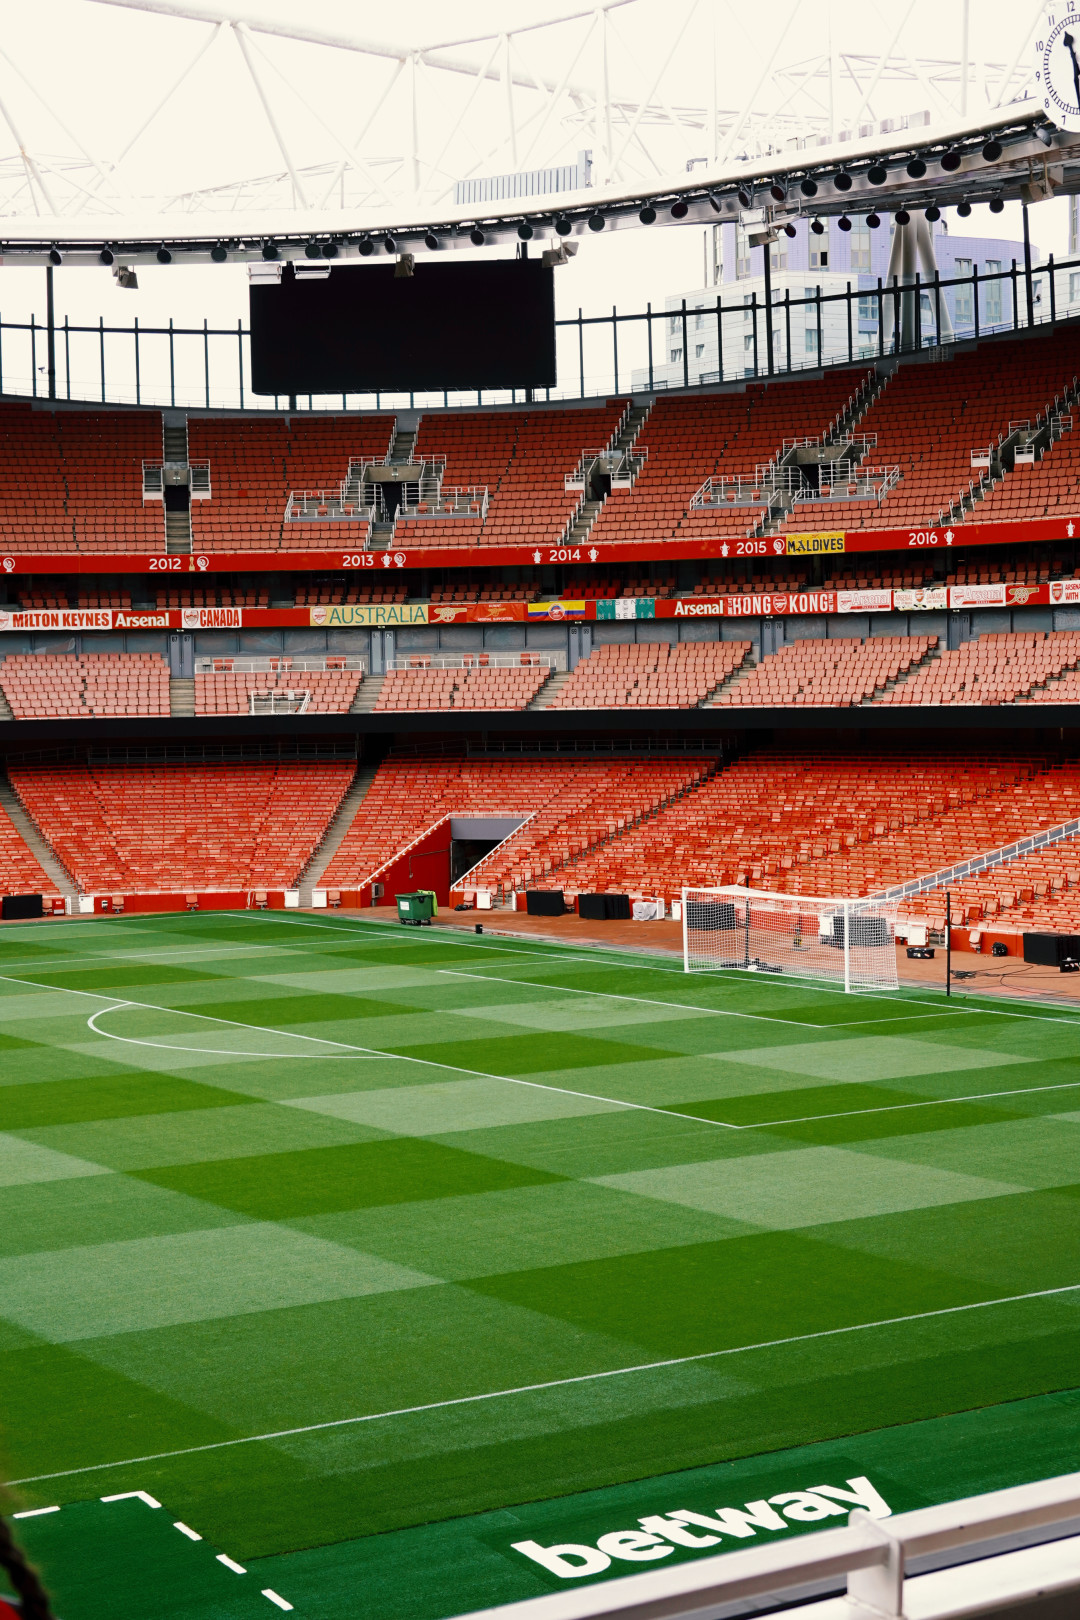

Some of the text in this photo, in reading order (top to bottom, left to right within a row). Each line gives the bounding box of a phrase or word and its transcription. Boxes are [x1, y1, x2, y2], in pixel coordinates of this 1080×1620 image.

[1067, 1, 1075, 12] 12
[1048, 15, 1055, 26] 11
[1036, 41, 1044, 51] 10
[1036, 71, 1040, 81] 9
[1044, 98, 1050, 108] 8
[1061, 115, 1066, 125] 7
[788, 538, 843, 552] MALDIVES
[909, 532, 938, 545] 2016
[737, 542, 767, 554] 2015
[343, 555, 374, 567] 2013
[549, 549, 581, 561] 2014
[149, 558, 181, 570] 2012
[852, 592, 890, 605] Arsenal
[965, 587, 1003, 600] Arsenal
[674, 600, 723, 615] Arsenal
[733, 593, 828, 615] HONG KONG
[13, 613, 109, 627] MILTON KEYNES
[115, 613, 170, 627] Arsenal
[200, 609, 240, 627] CANADA
[329, 606, 426, 624] AUSTRALIA
[510, 1476, 892, 1579] betway
